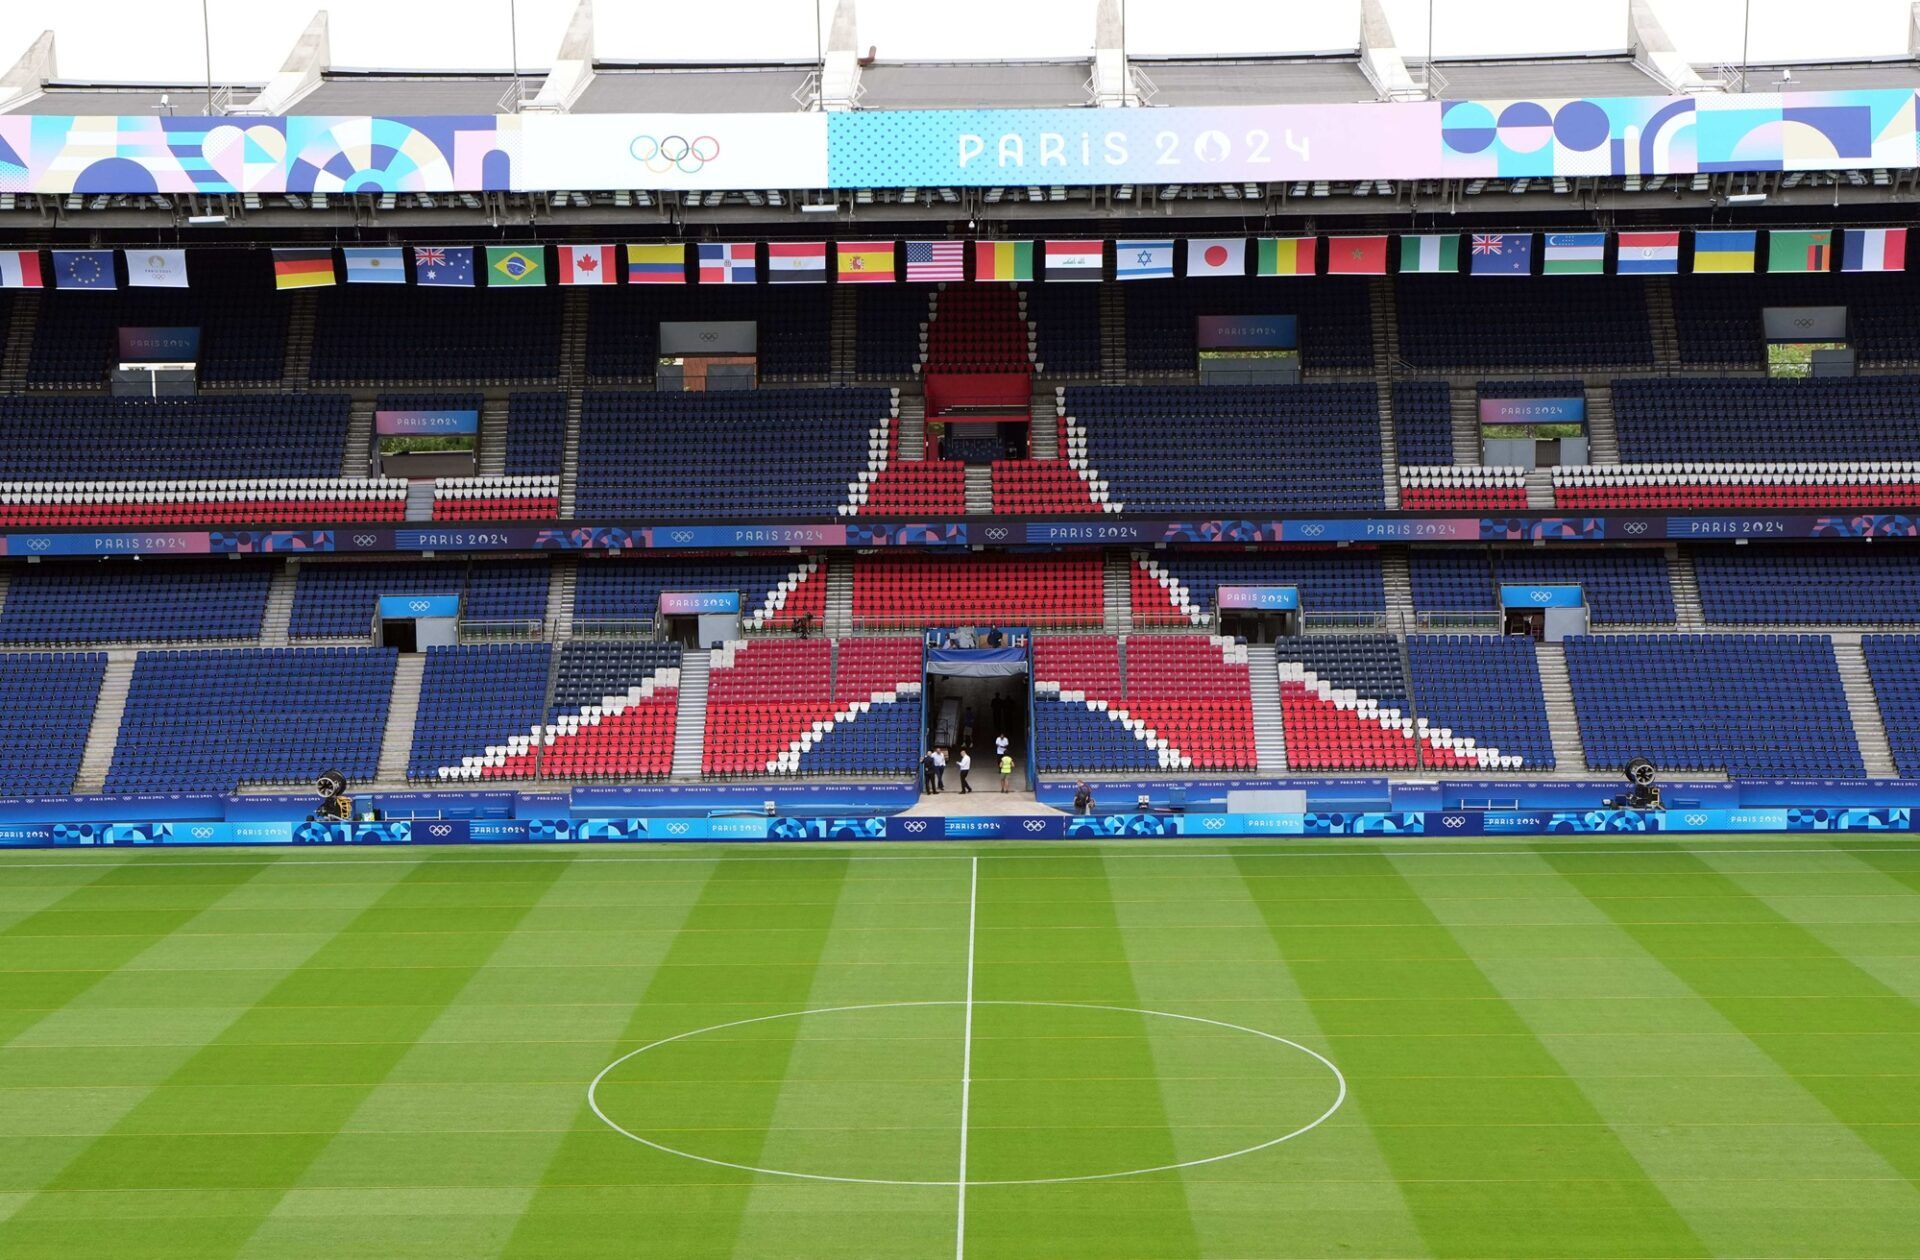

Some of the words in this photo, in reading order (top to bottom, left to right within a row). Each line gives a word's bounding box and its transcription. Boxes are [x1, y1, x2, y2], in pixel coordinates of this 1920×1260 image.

[959, 131, 1129, 168] PARIS
[1155, 128, 1311, 166] 2024
[1050, 528, 1093, 538] PARIS
[1098, 527, 1137, 537] 2024
[1367, 524, 1410, 535] PARIS
[1416, 524, 1455, 535] 2024
[1692, 522, 1736, 533] PARIS
[1743, 521, 1783, 532] 2024
[420, 534, 463, 545] PARIS
[468, 534, 507, 544] 2024
[736, 530, 778, 541] PARIS
[784, 530, 822, 541] 2024
[95, 538, 139, 549] PARIS
[145, 537, 185, 548] 2024
